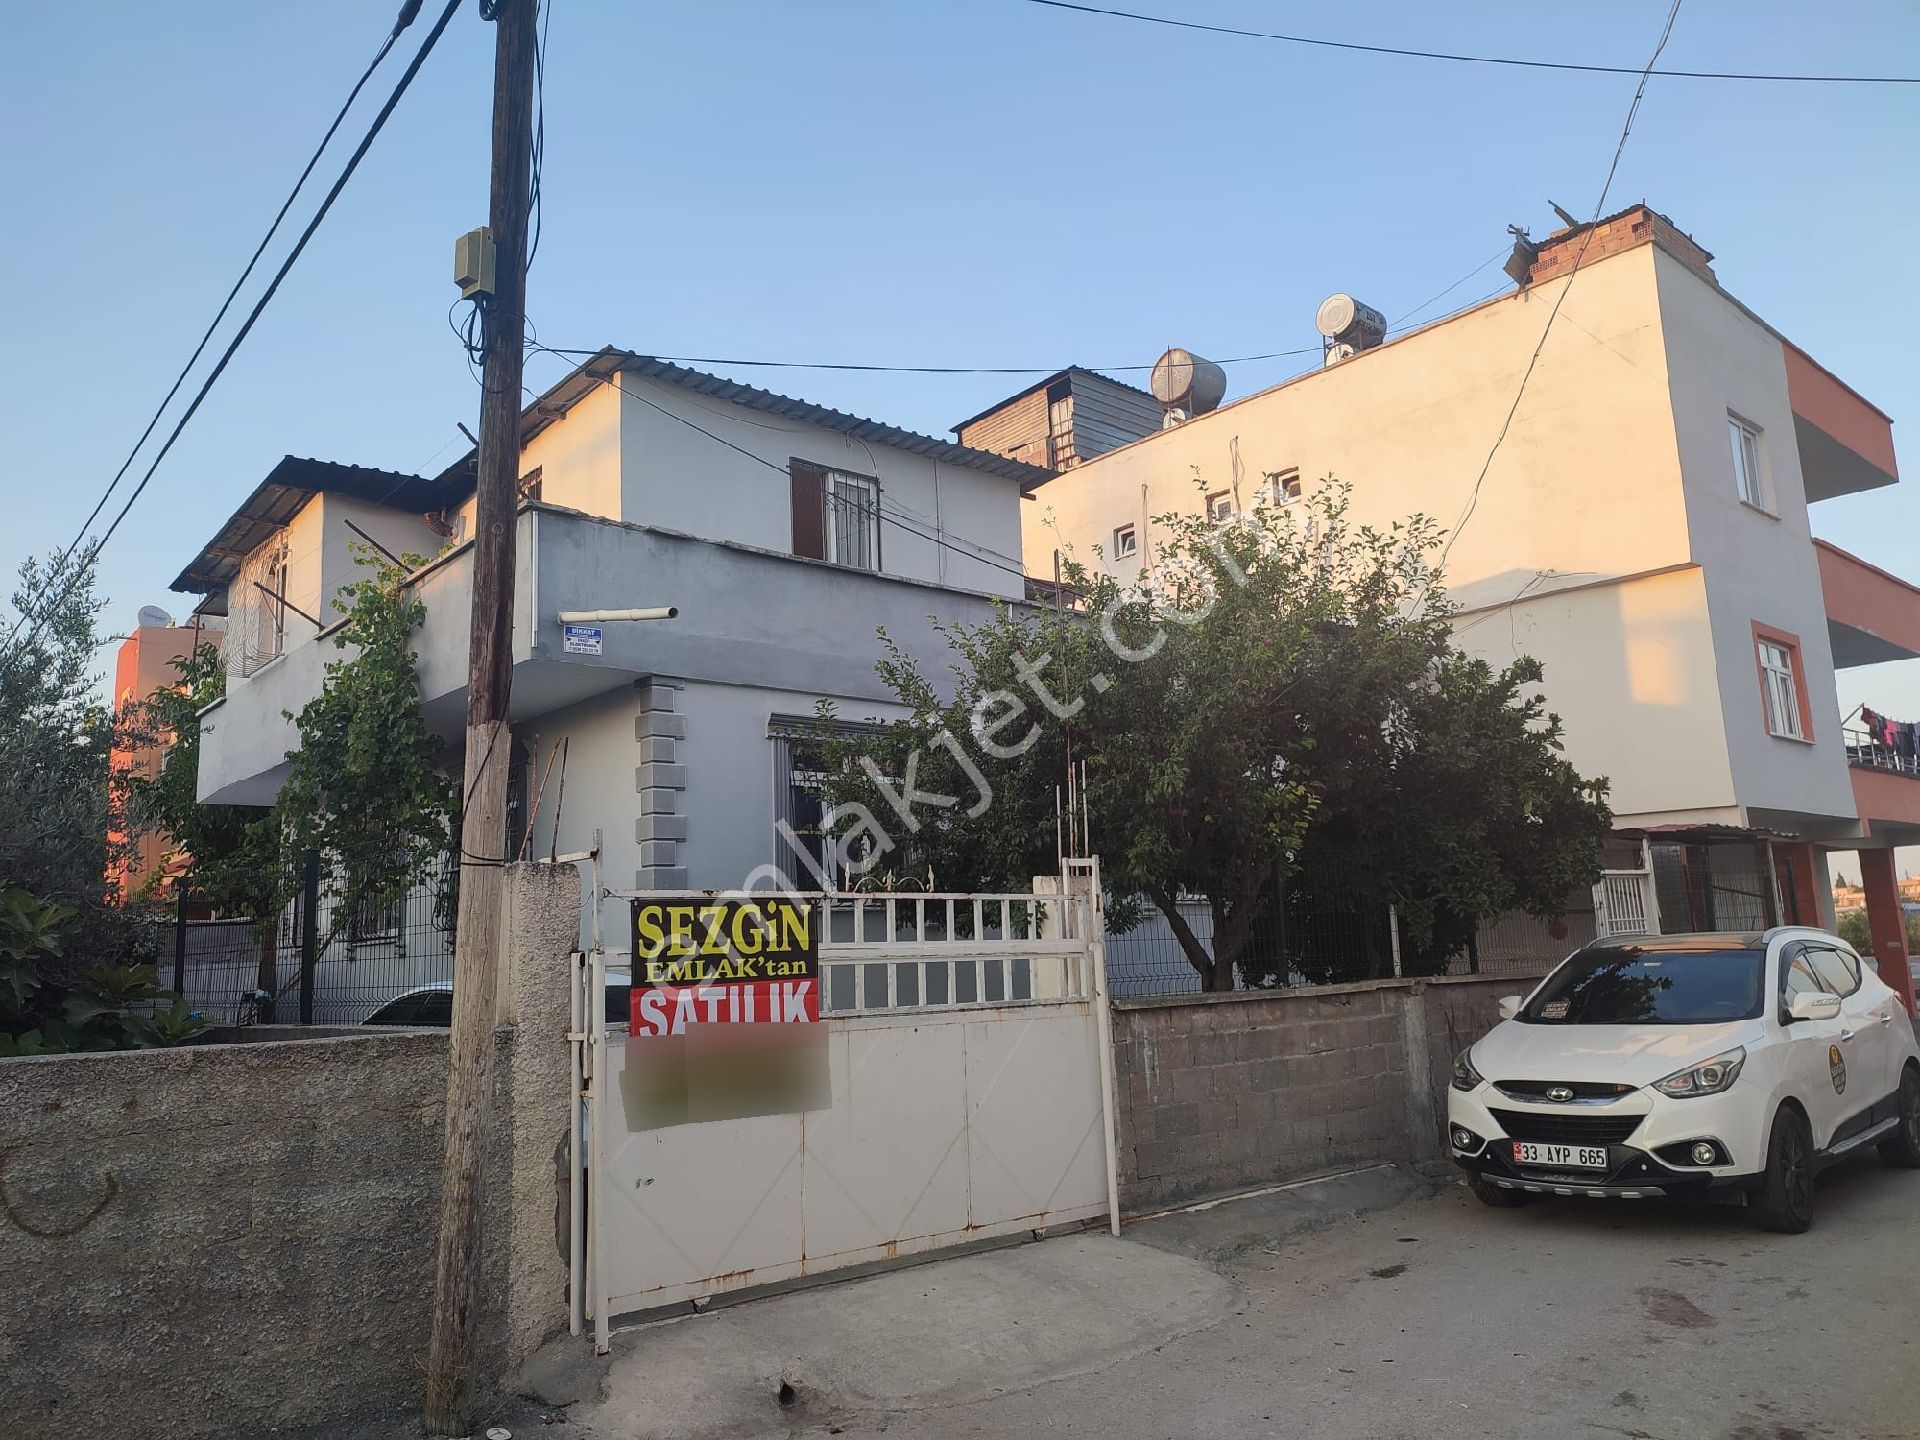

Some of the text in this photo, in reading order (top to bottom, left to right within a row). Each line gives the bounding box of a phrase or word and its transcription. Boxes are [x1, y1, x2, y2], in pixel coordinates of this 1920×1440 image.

[1522, 1145, 1538, 1161] 33
[1547, 1146, 1571, 1163] AYP
[1579, 1149, 1605, 1165] 665
